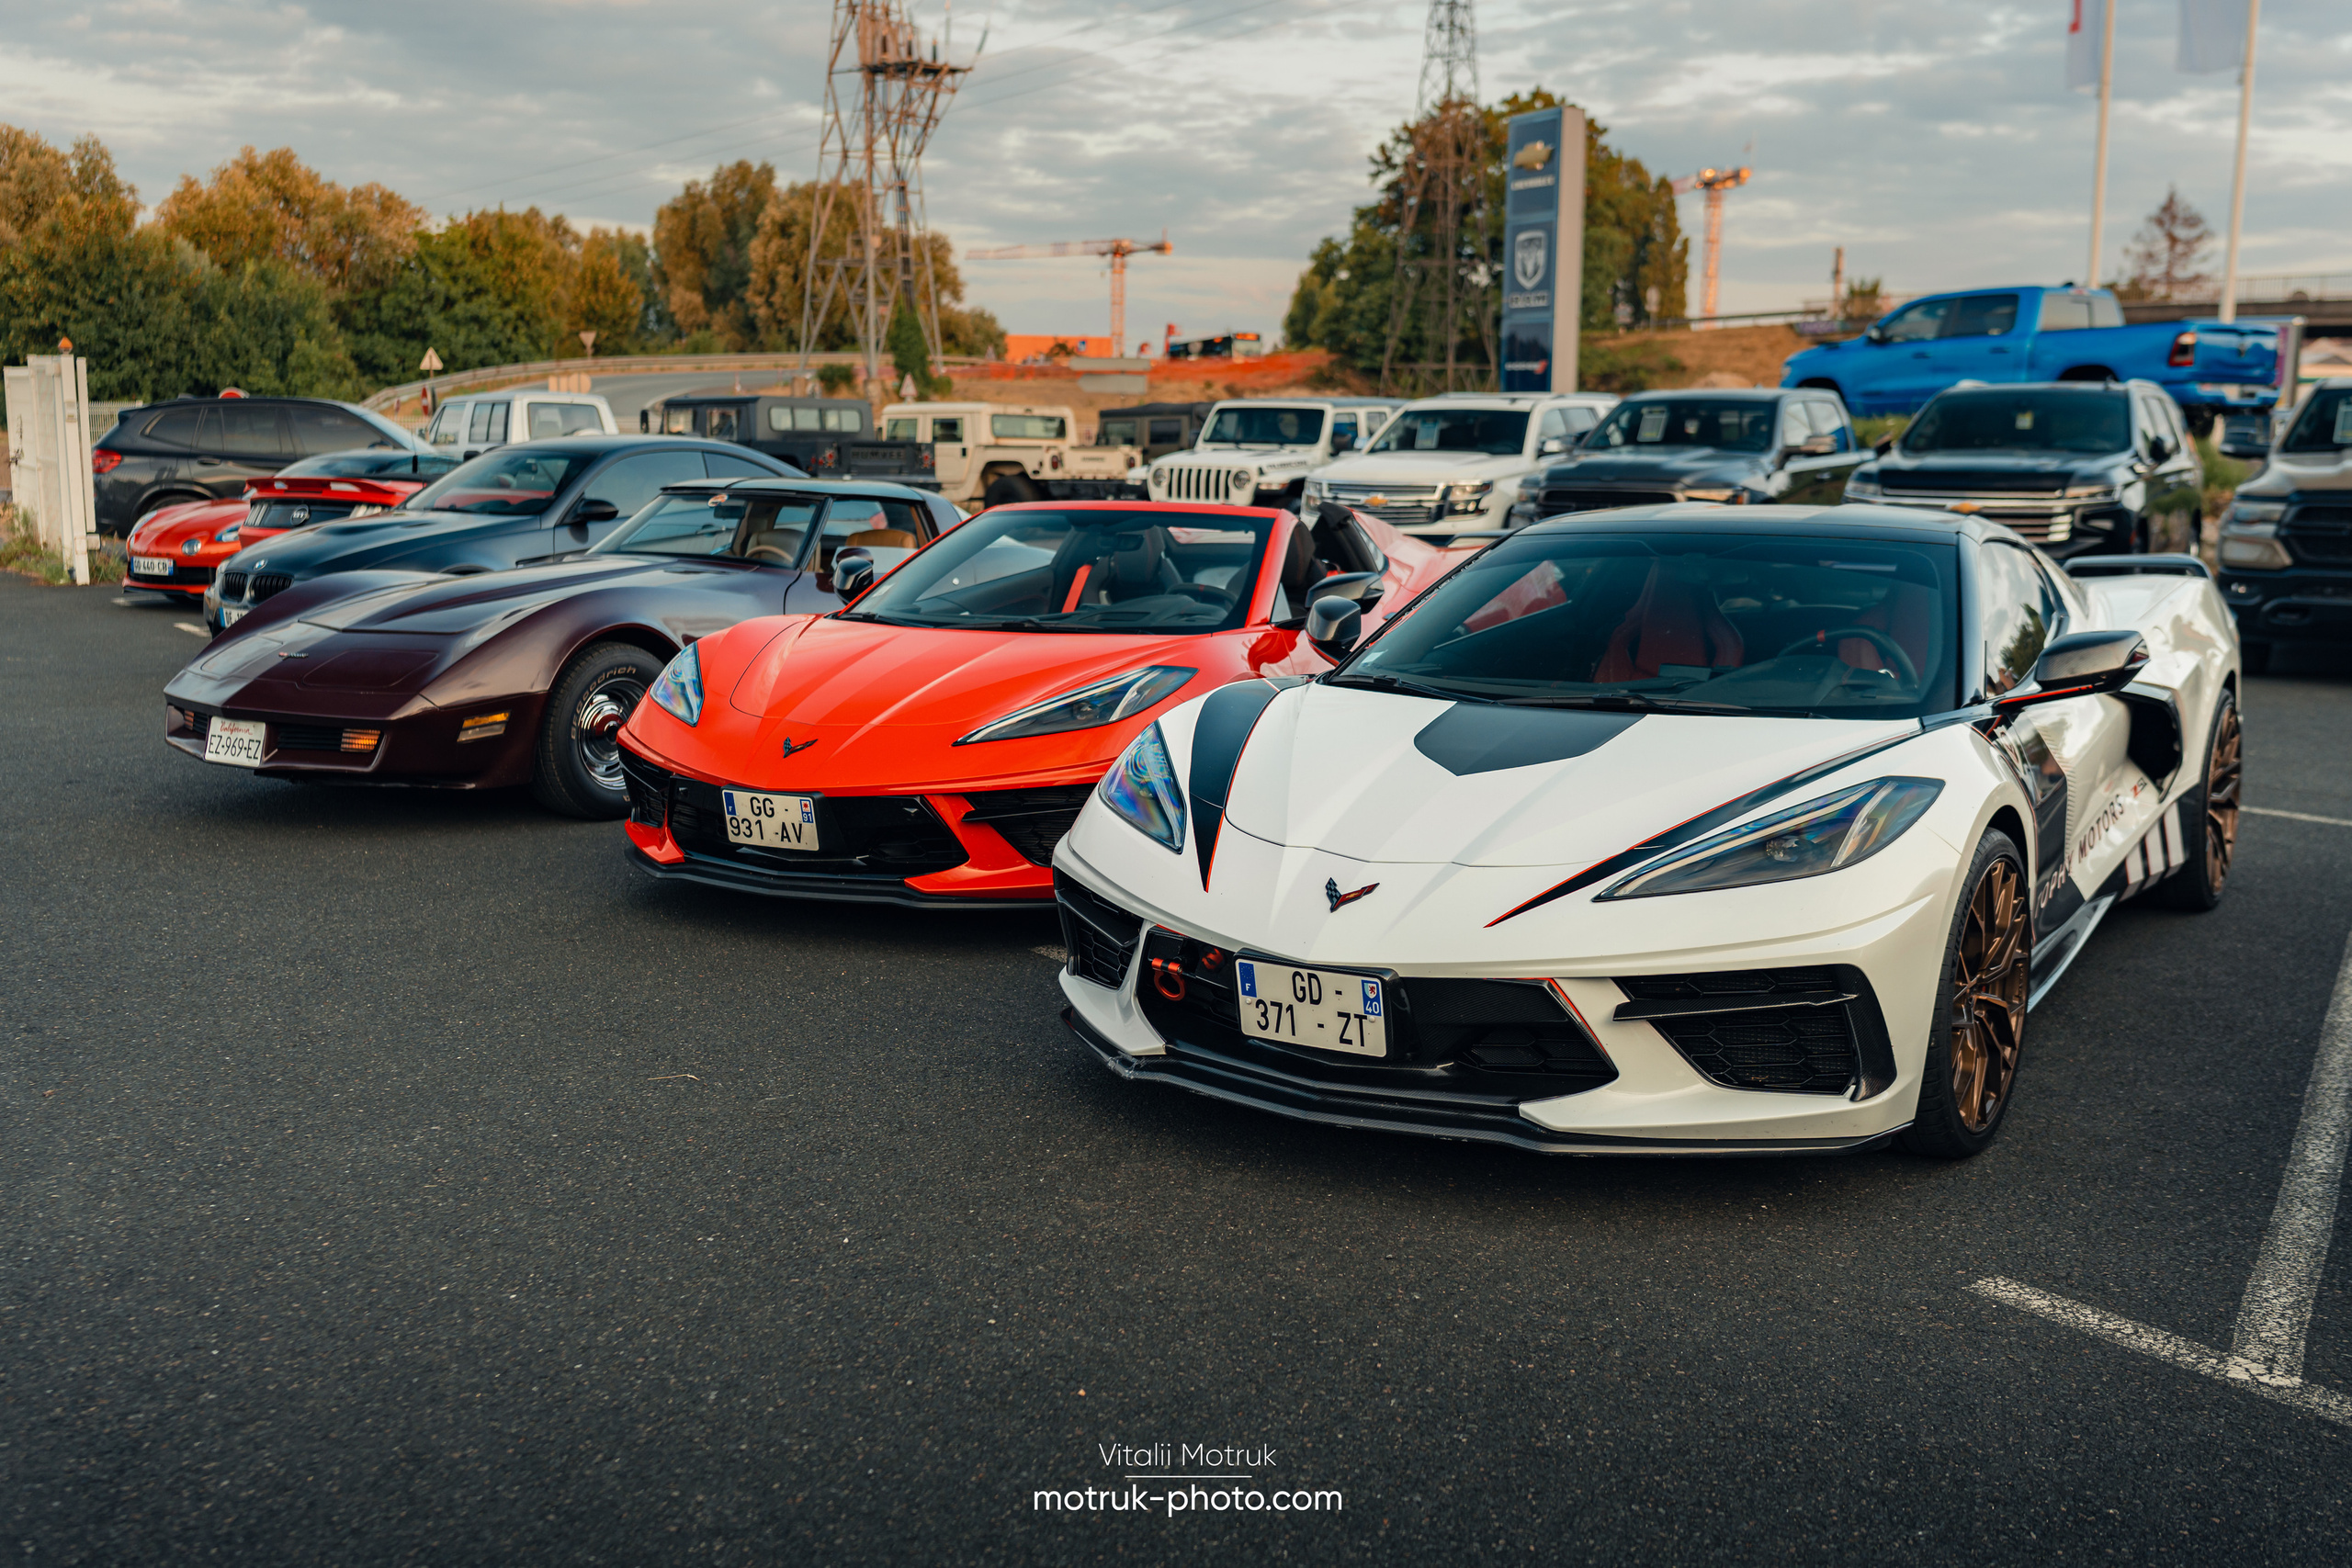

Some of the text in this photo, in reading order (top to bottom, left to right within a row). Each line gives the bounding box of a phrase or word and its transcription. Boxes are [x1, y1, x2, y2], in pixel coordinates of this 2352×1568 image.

[209, 734, 262, 760] EZ-969-EZ
[750, 796, 775, 818] GG
[802, 813, 813, 822] 91
[729, 817, 764, 840] 931
[2078, 794, 2124, 863] MOTORS
[1245, 983, 1251, 991] F
[1292, 971, 1322, 1005] GD
[1365, 1001, 1380, 1014] 40
[1255, 998, 1296, 1036] 371
[1337, 1011, 1368, 1047] ZT
